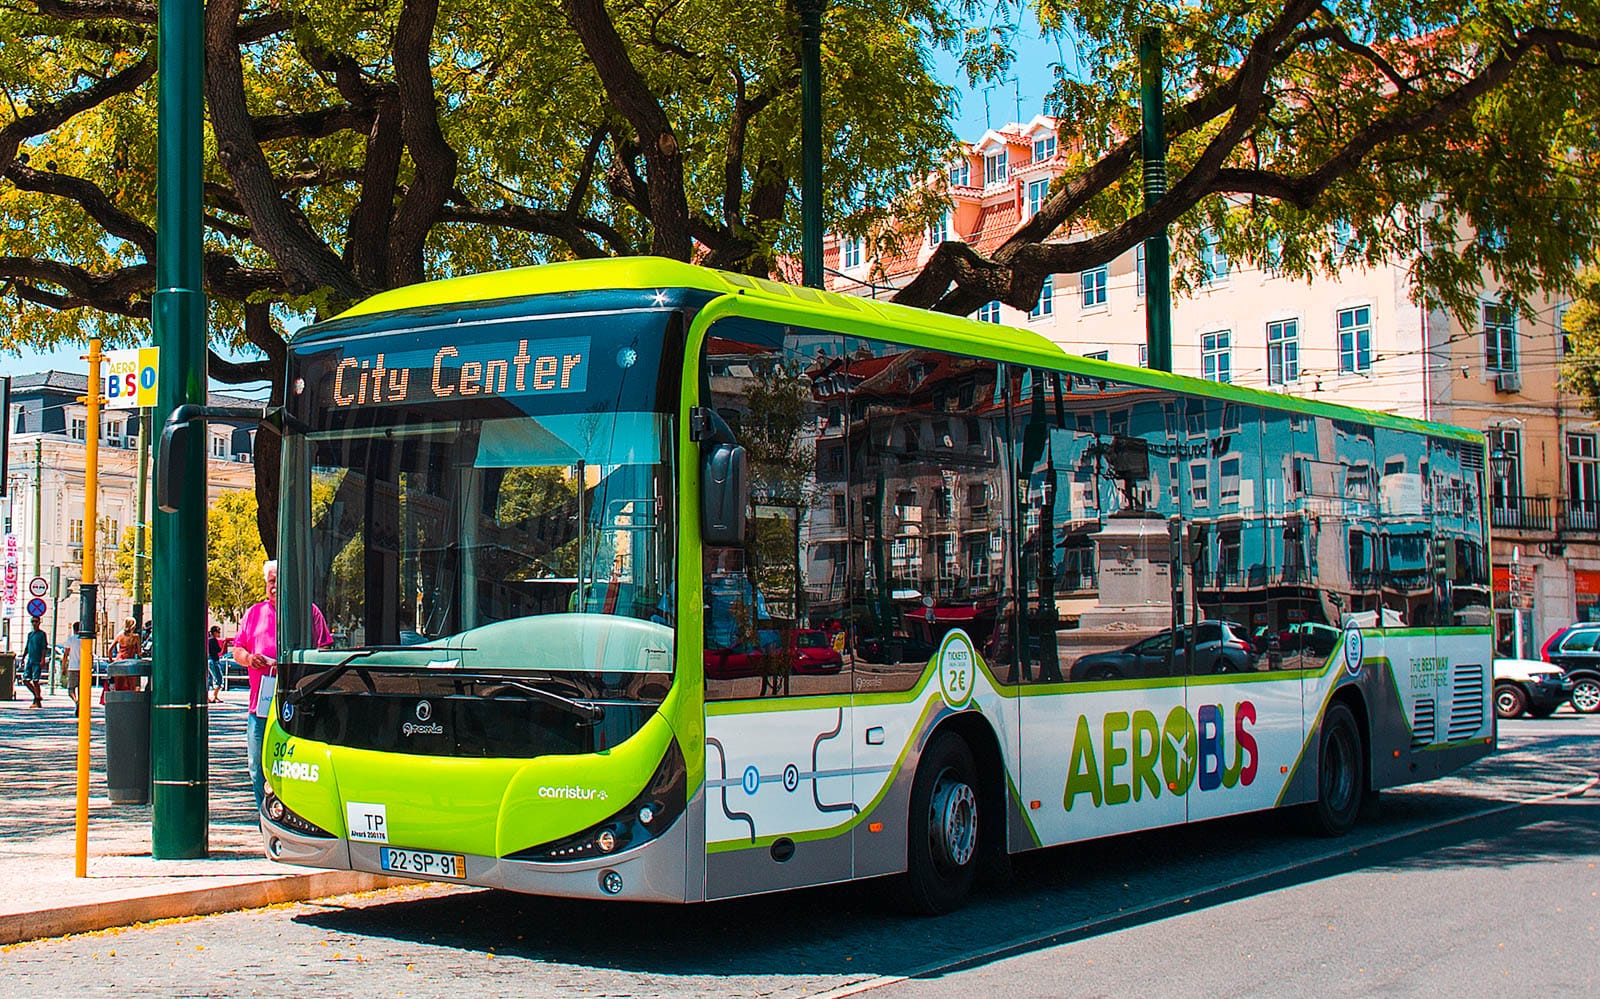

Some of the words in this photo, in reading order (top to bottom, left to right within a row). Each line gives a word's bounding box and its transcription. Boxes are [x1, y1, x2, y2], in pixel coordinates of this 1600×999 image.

[109, 361, 136, 375] AERO
[333, 352, 409, 407] City
[431, 339, 582, 398] Center
[108, 373, 137, 398] BUS
[947, 651, 967, 661] TICKETS
[1409, 657, 1421, 673] THE
[1422, 656, 1435, 672] BEST
[949, 669, 966, 692] 2€
[273, 741, 296, 758] 304
[1063, 700, 1259, 812] AEROBUS
[272, 759, 320, 783] AEROBUS
[538, 785, 596, 800] carristur
[364, 814, 384, 831] TP
